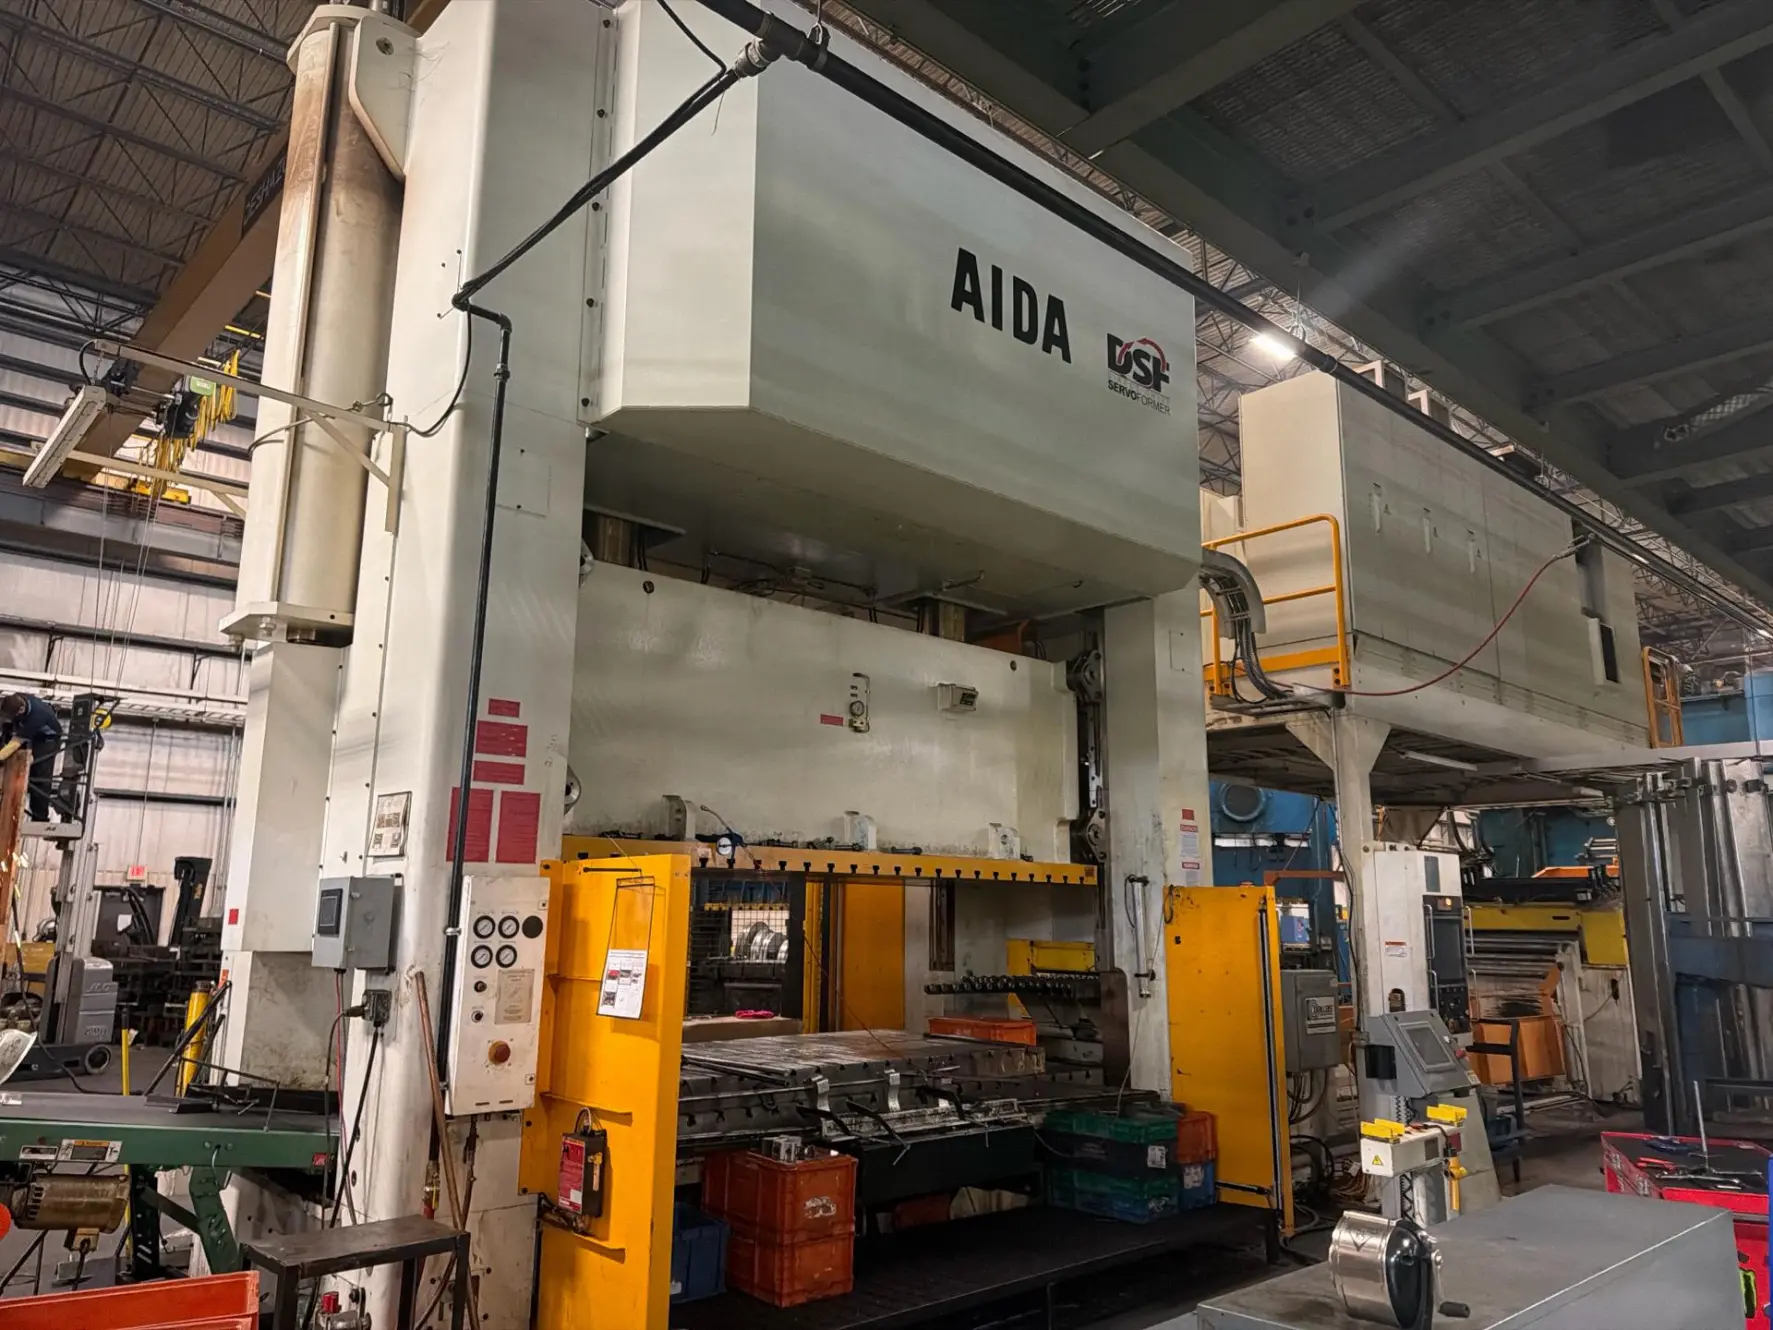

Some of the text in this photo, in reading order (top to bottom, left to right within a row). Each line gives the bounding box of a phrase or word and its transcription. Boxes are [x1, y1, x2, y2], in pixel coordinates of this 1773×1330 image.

[950, 247, 1072, 364] AIDA
[1107, 333, 1170, 393] DSF
[1107, 379, 1171, 416] SERVOFORMER
[85, 982, 111, 993] JLG
